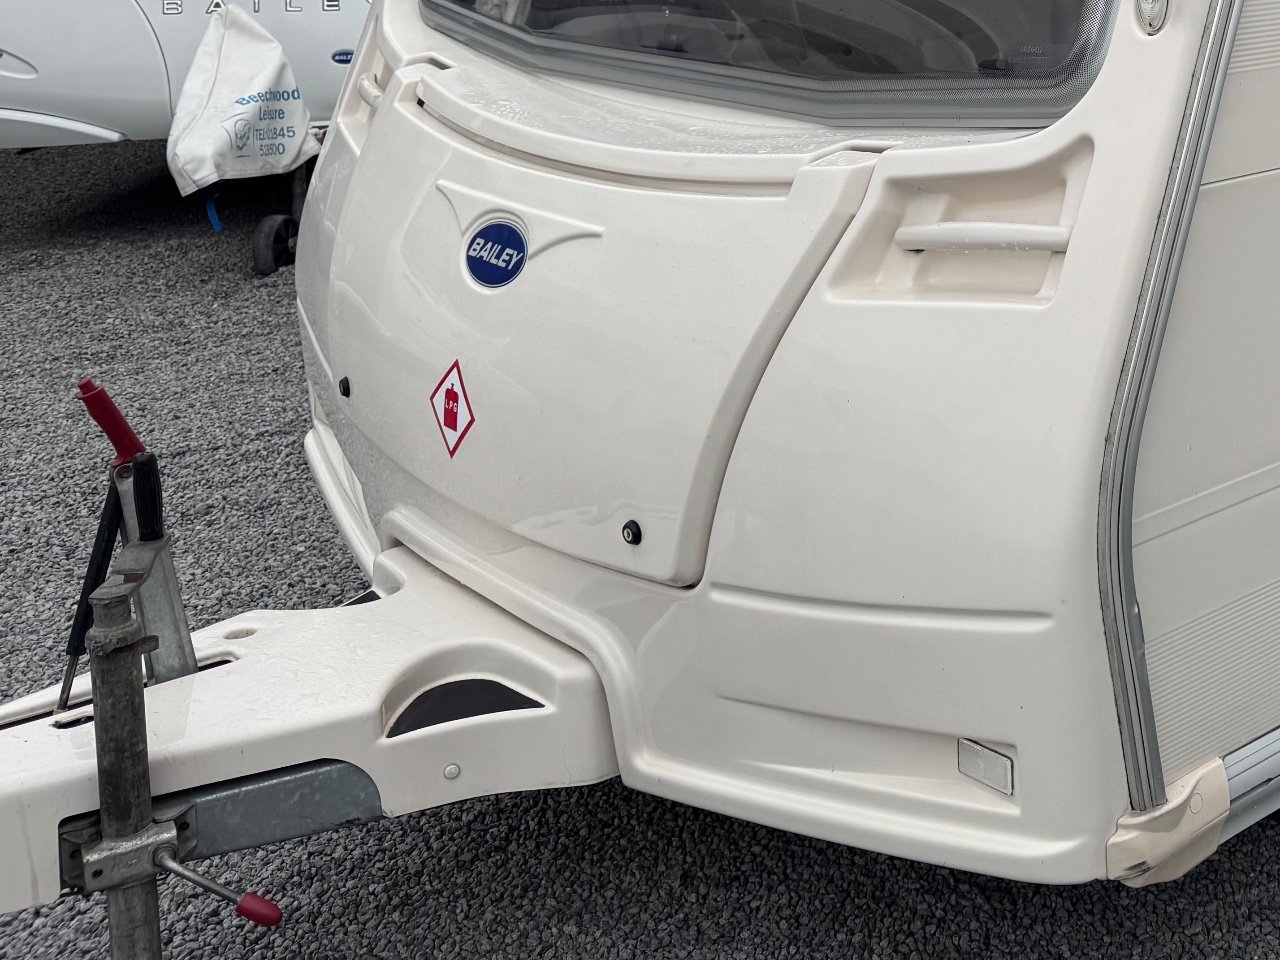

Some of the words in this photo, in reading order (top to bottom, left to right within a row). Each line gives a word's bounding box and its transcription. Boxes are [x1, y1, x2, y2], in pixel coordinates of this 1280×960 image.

[235, 86, 300, 105] Beechwood
[259, 106, 285, 121] Leisure
[468, 237, 523, 270] BAILEY
[445, 399, 458, 413] LPG
